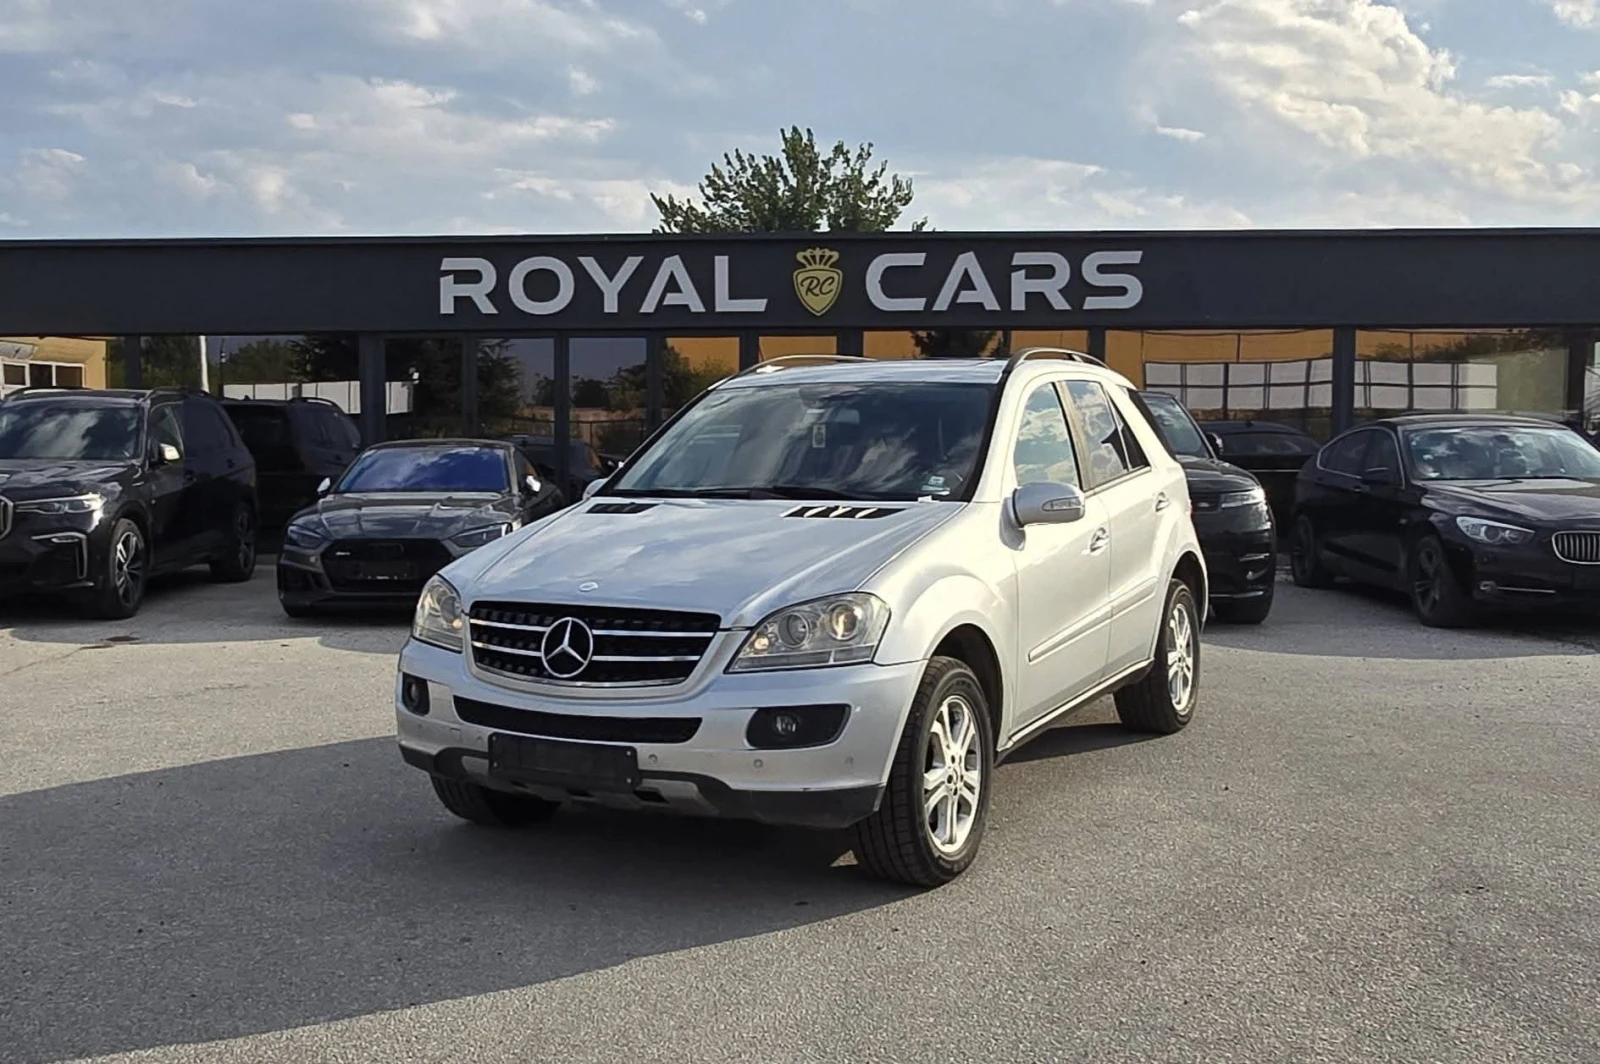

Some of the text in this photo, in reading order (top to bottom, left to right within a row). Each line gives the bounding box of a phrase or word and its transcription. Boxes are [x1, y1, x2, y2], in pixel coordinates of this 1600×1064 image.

[439, 250, 1143, 315] ROYAL CARS
[800, 276, 835, 297] RC
